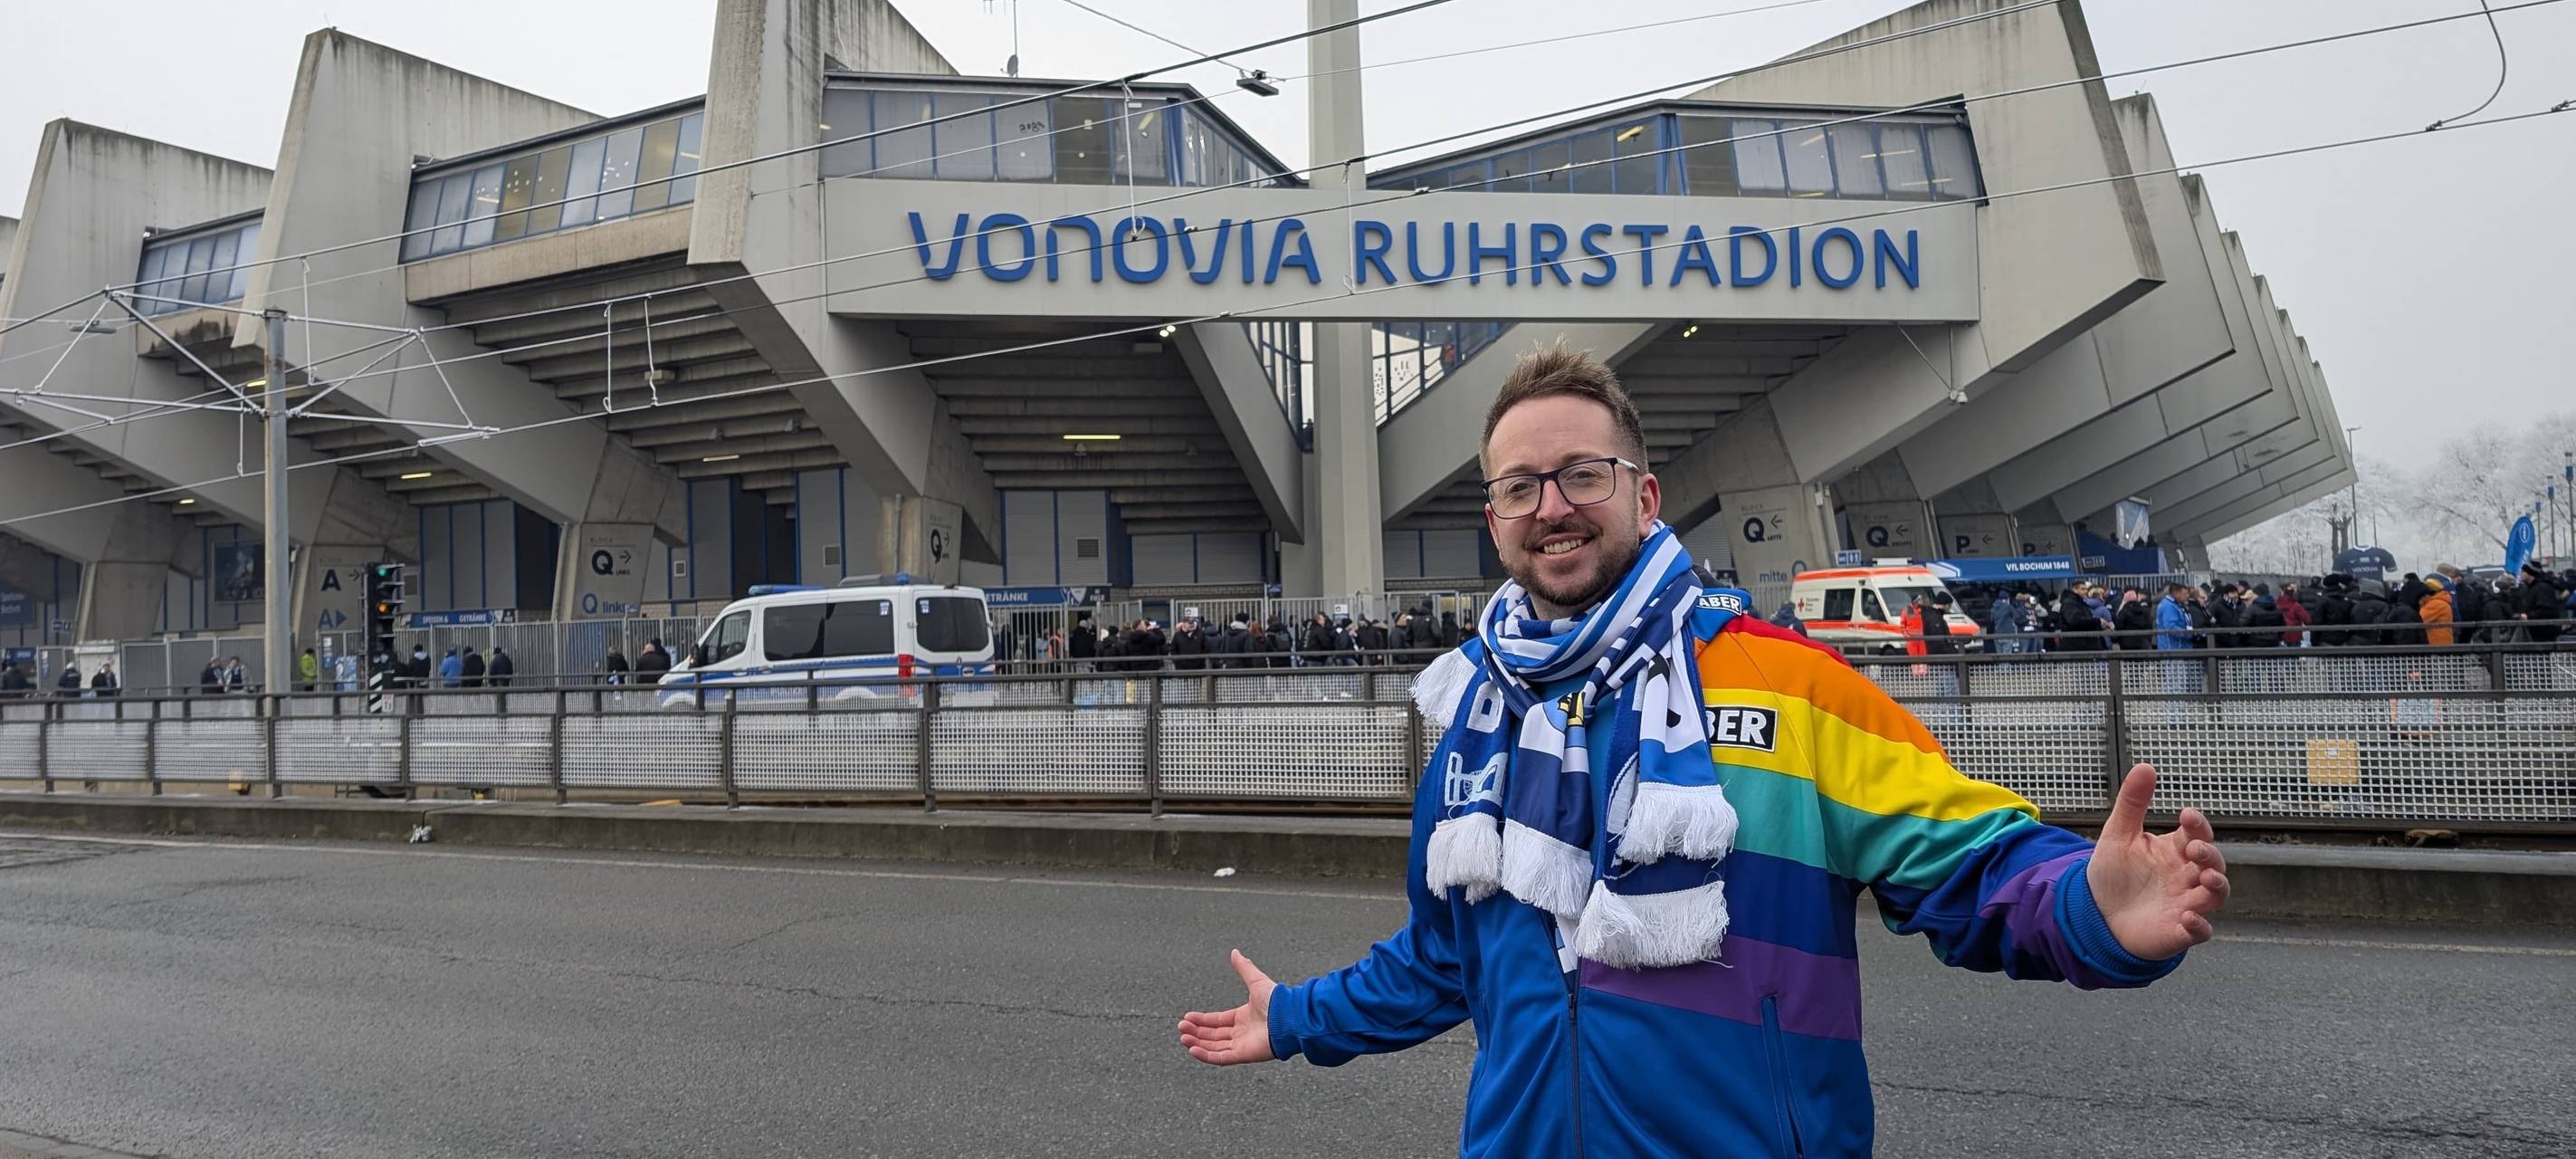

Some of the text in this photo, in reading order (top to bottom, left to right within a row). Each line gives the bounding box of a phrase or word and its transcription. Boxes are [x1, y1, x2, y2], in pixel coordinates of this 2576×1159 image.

[908, 211, 1919, 290] VONOVIA RUHRSTADION
[1743, 517, 1765, 542] Q
[1866, 526, 1889, 548] Q
[930, 530, 942, 563] Q
[1956, 535, 1970, 553] P
[591, 550, 614, 575] Q
[2019, 561, 2052, 570] BOCHUM
[2054, 560, 2070, 570] 1848
[320, 569, 341, 591] A
[1759, 570, 1788, 582] mitte
[582, 594, 597, 614] Q
[986, 591, 1028, 602] ETRÄNKE
[1699, 596, 1741, 612] ABER
[318, 608, 333, 628] A
[1704, 710, 1766, 745] BER
